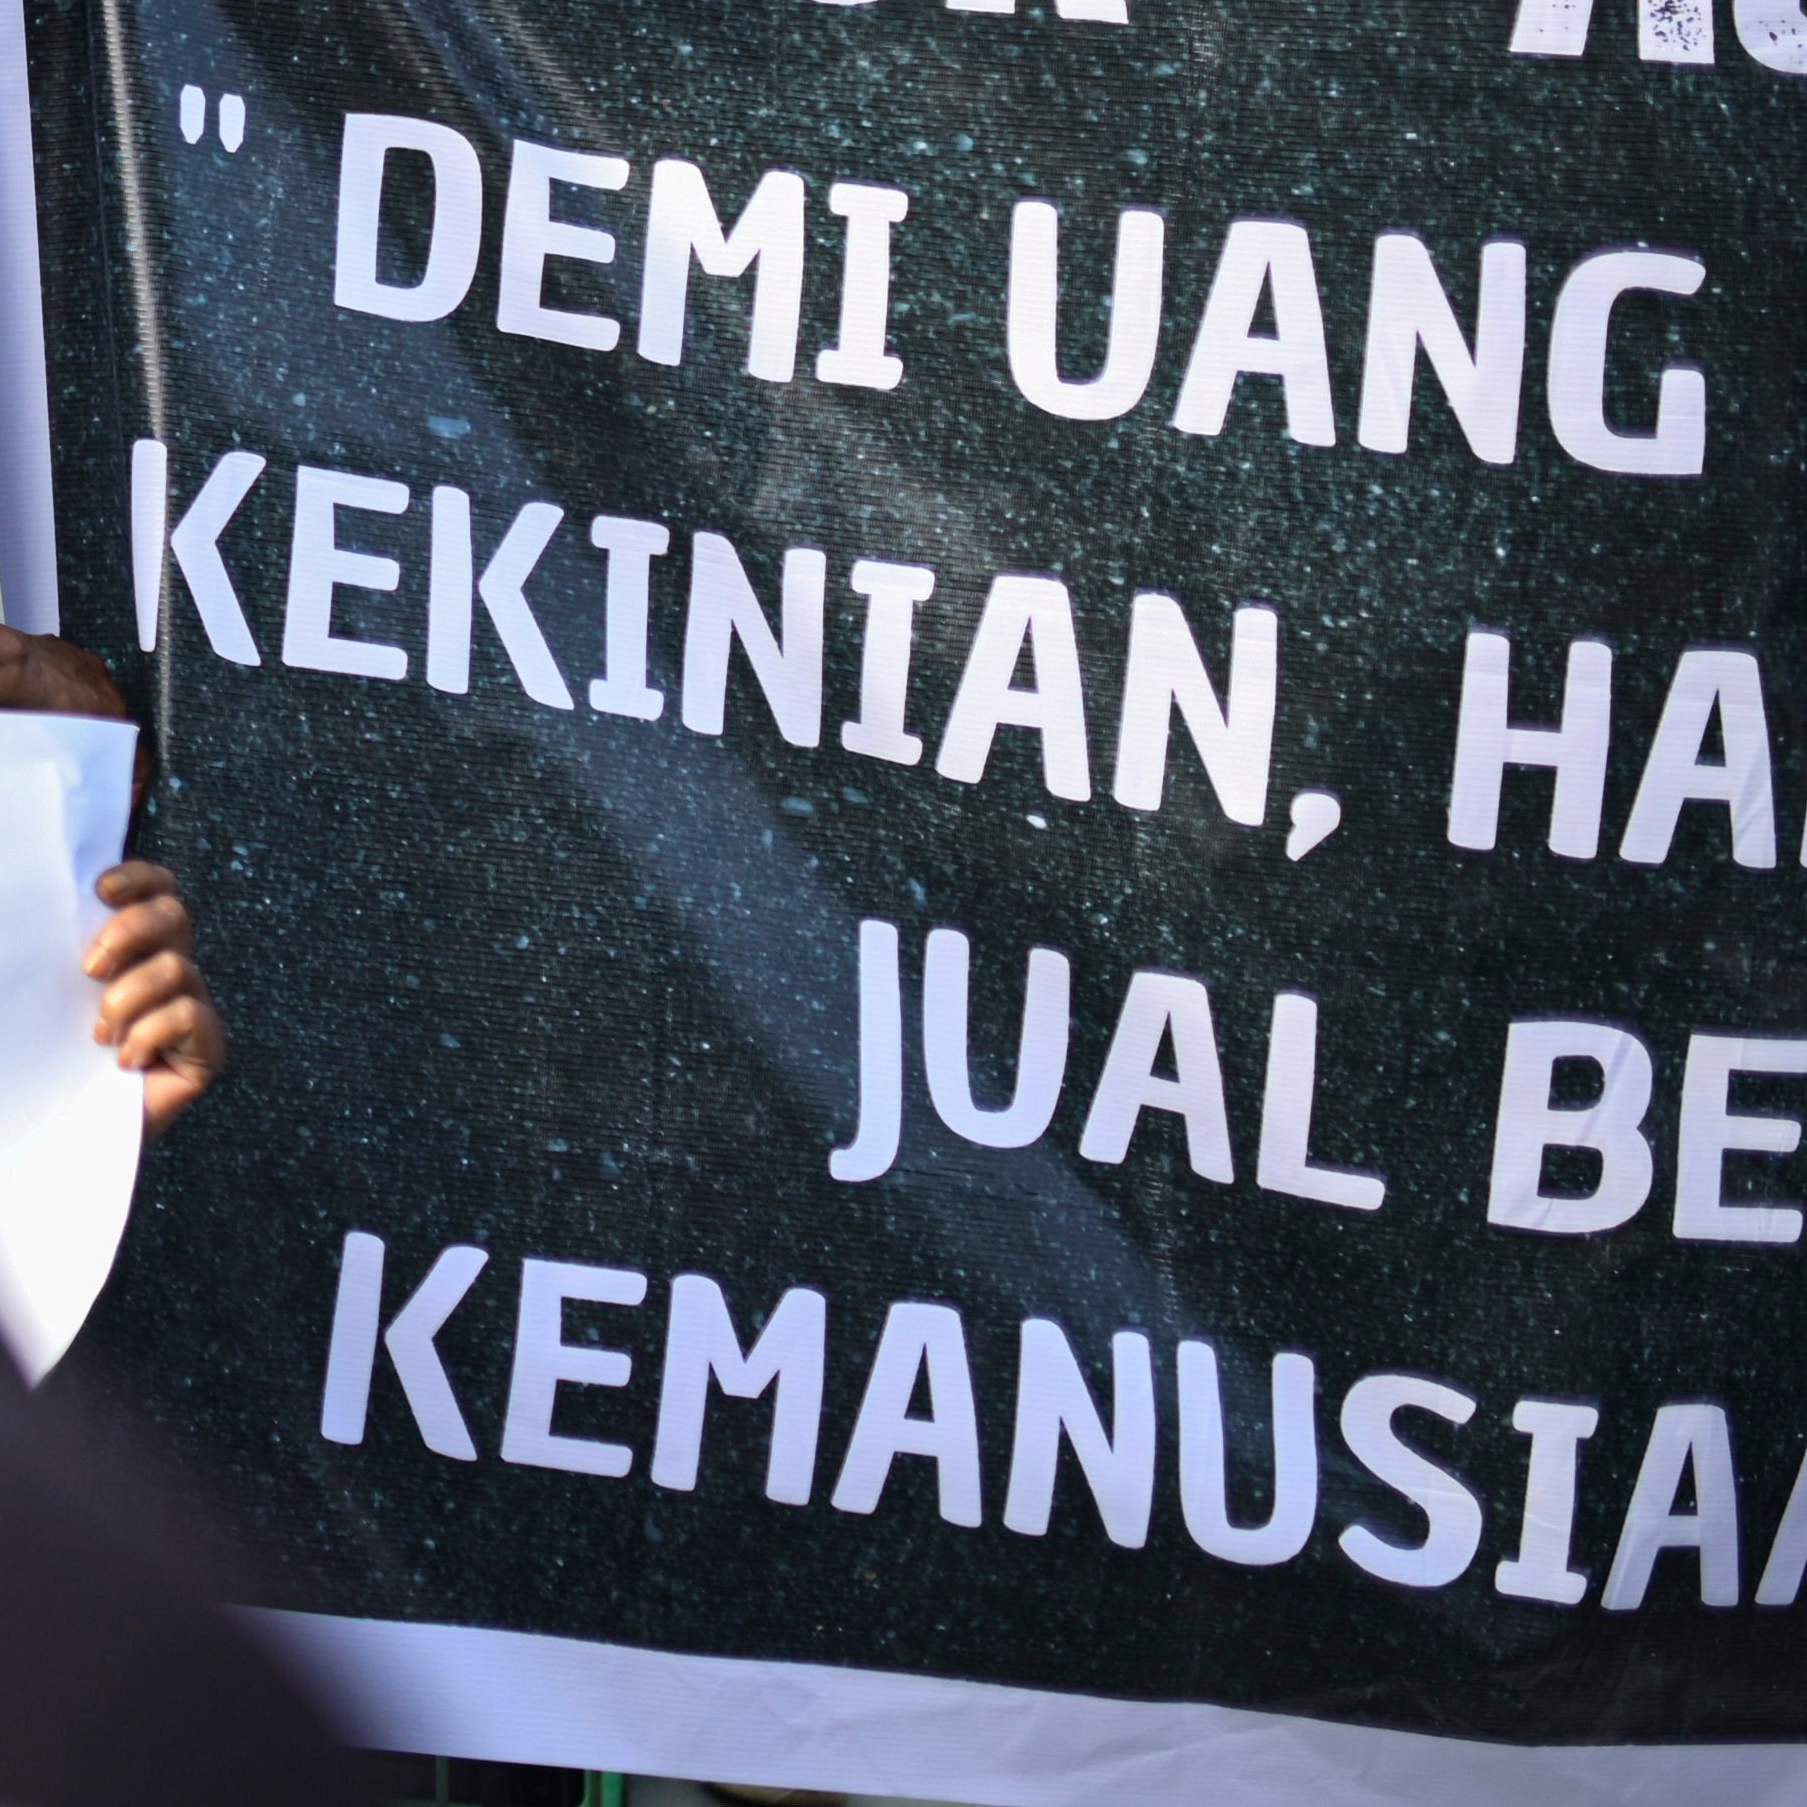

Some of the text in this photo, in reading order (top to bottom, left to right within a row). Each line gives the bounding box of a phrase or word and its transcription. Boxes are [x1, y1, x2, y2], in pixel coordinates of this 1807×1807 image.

[334, 111, 909, 390] DEMI
[1007, 200, 1707, 477] UANG
[128, 438, 1807, 869] KEKINIAN, HA
[828, 918, 1385, 1210] JUAL
